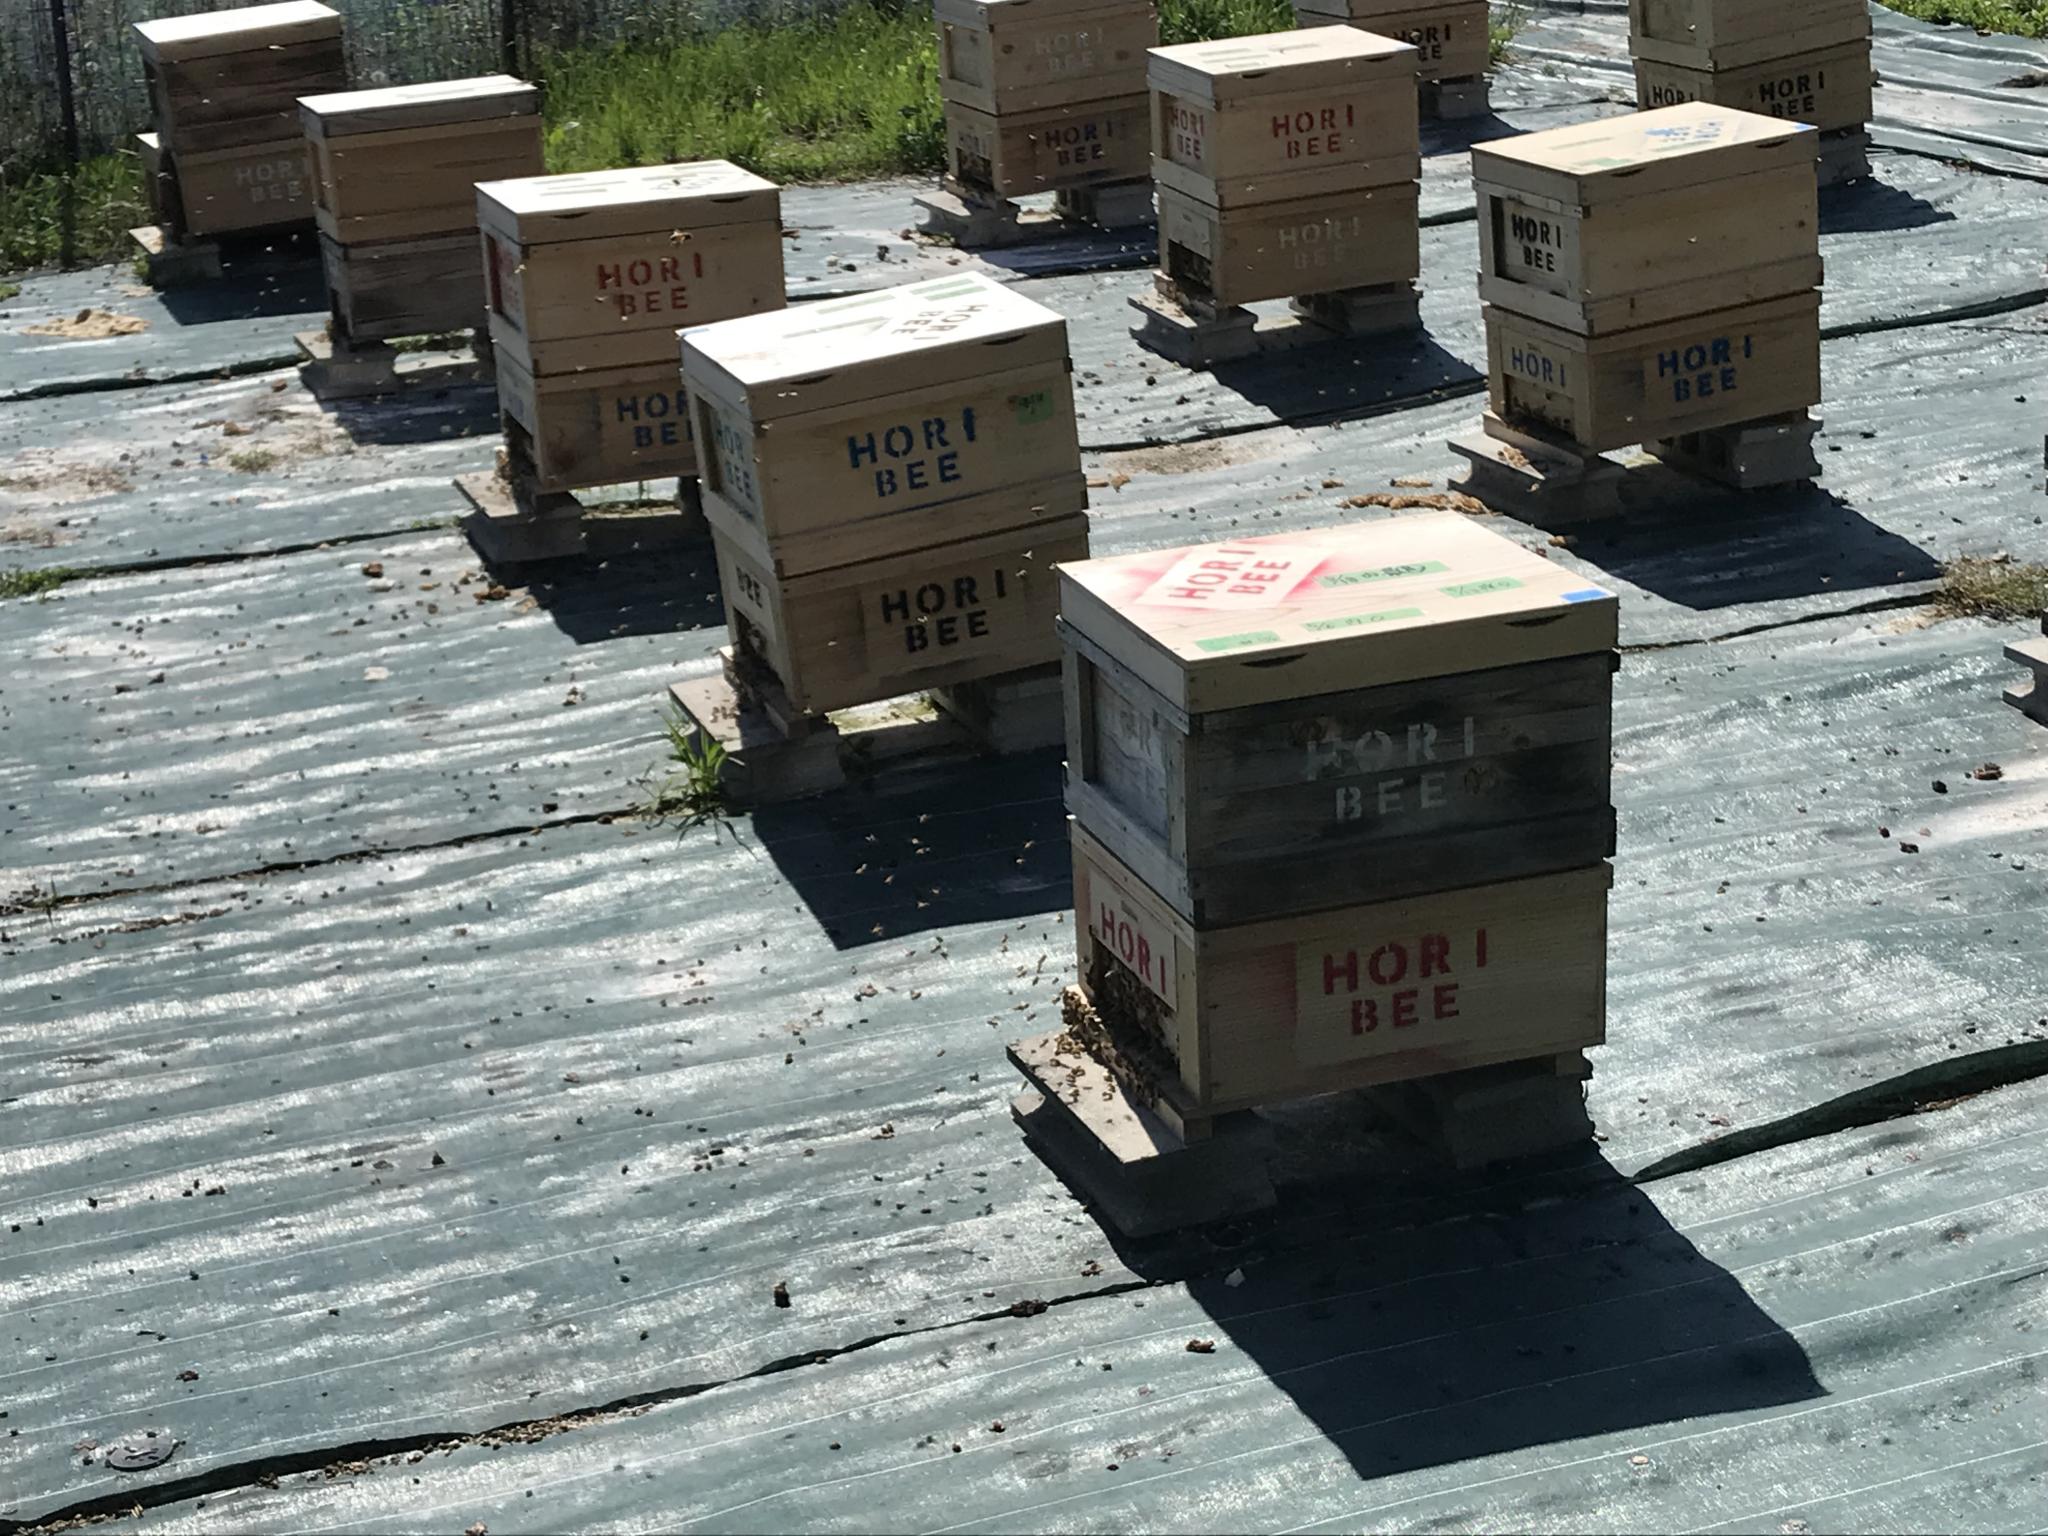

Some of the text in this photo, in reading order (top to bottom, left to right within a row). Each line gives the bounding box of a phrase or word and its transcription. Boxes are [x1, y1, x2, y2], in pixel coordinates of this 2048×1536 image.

[1418, 44, 1443, 62] EE
[1759, 71, 1825, 103] HORI
[1170, 105, 1205, 138] HORI
[1272, 104, 1355, 138] HORI
[1771, 95, 1816, 117] BEE
[1045, 120, 1113, 148] HORI
[1177, 134, 1201, 160] BEE
[1287, 132, 1342, 159] BEE
[1058, 144, 1104, 166] BEE
[1279, 217, 1361, 249] HORI
[1511, 213, 1562, 250] HORI
[597, 252, 704, 290] HORI
[1523, 248, 1556, 273] BEE
[617, 287, 689, 317] BEE
[1511, 346, 1566, 389] HORI
[1657, 335, 1753, 378] HORI
[1674, 367, 1738, 402] BEE
[616, 390, 690, 422] HOR
[847, 406, 976, 468] HORI
[875, 452, 962, 498] BEE
[1168, 548, 1256, 600] HORI
[1226, 560, 1292, 595] BEE
[881, 569, 1006, 624] HORI
[905, 610, 989, 653] BEE
[1307, 716, 1475, 781] HORI
[1335, 771, 1449, 824] BEE
[1100, 901, 1167, 995] HORI
[1322, 928, 1488, 996] HORI
[1351, 983, 1461, 1036] BEE
